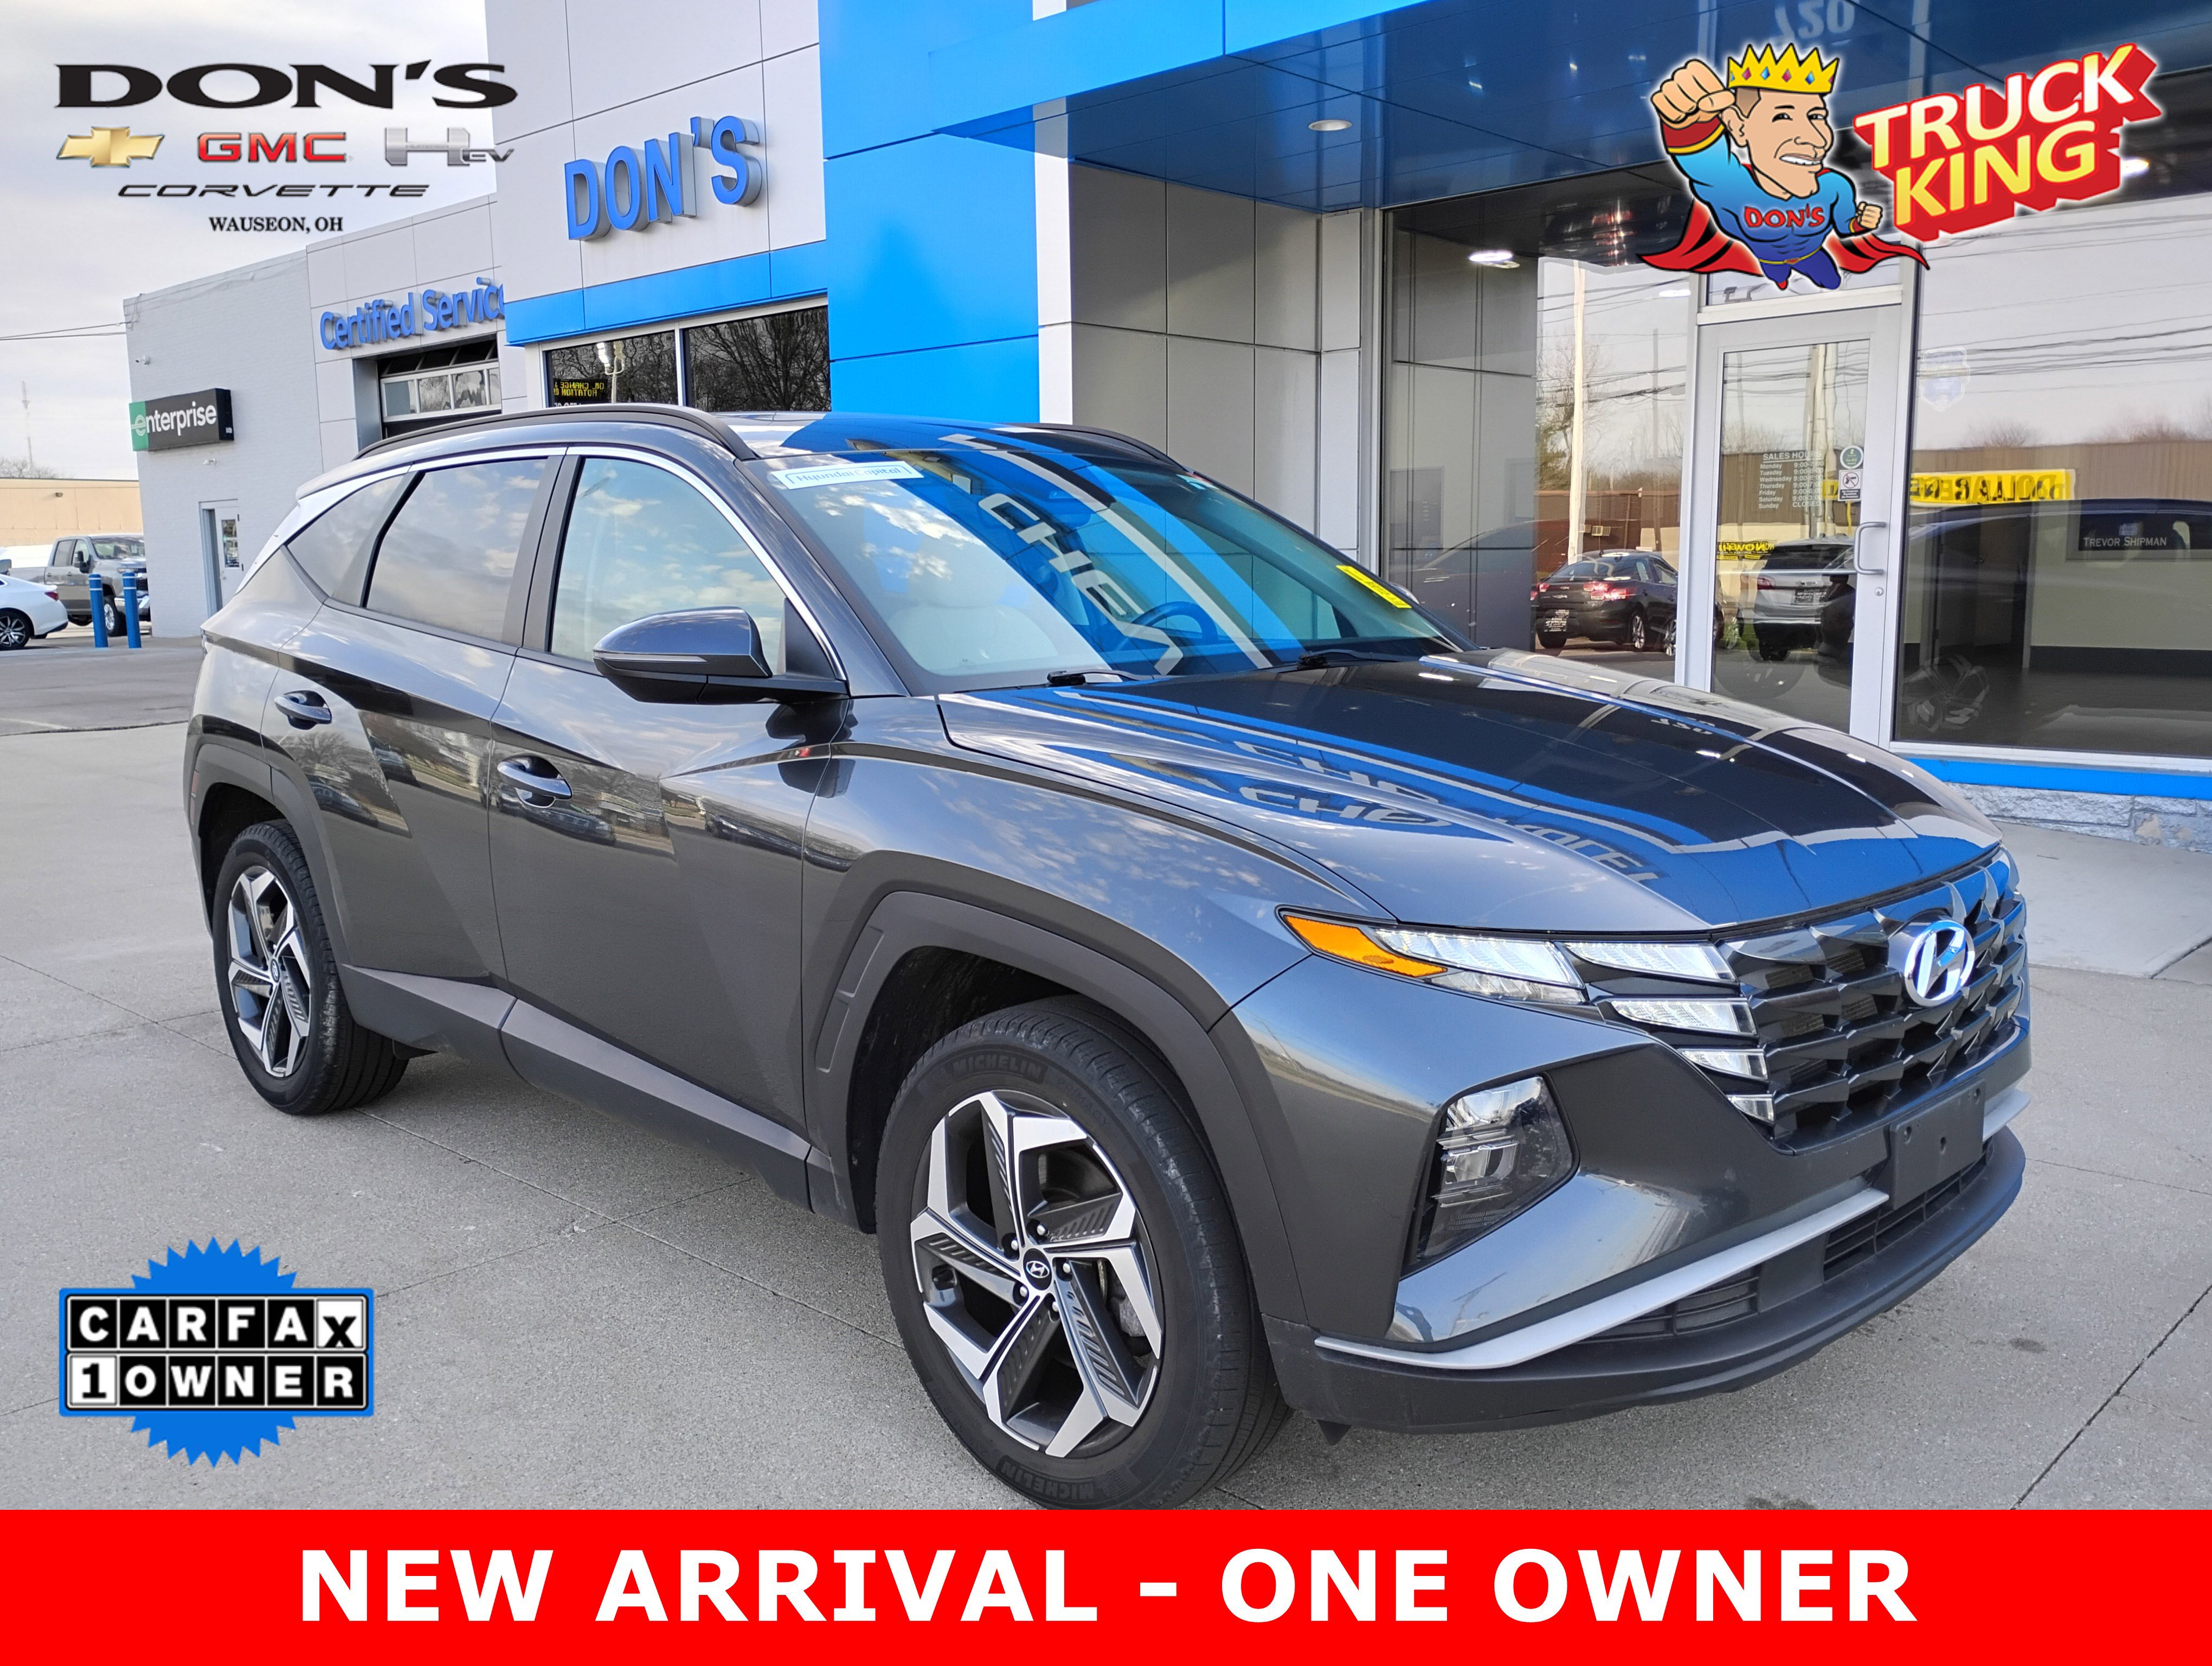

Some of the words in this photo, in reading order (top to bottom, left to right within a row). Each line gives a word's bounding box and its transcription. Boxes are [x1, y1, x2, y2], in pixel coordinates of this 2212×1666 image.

[564, 116, 761, 241] DON'S
[320, 292, 419, 350] Certified
[131, 401, 217, 436] enterprise
[1792, 451, 1822, 459] HOUS
[796, 471, 853, 481] Hyundai
[854, 467, 901, 477] Capital
[2084, 537, 2120, 547] TREVOR
[2124, 536, 2167, 547] SHIPMAN
[953, 1054, 1042, 1081] MICHELIN
[1000, 1460, 1095, 1501] MICHELIN
